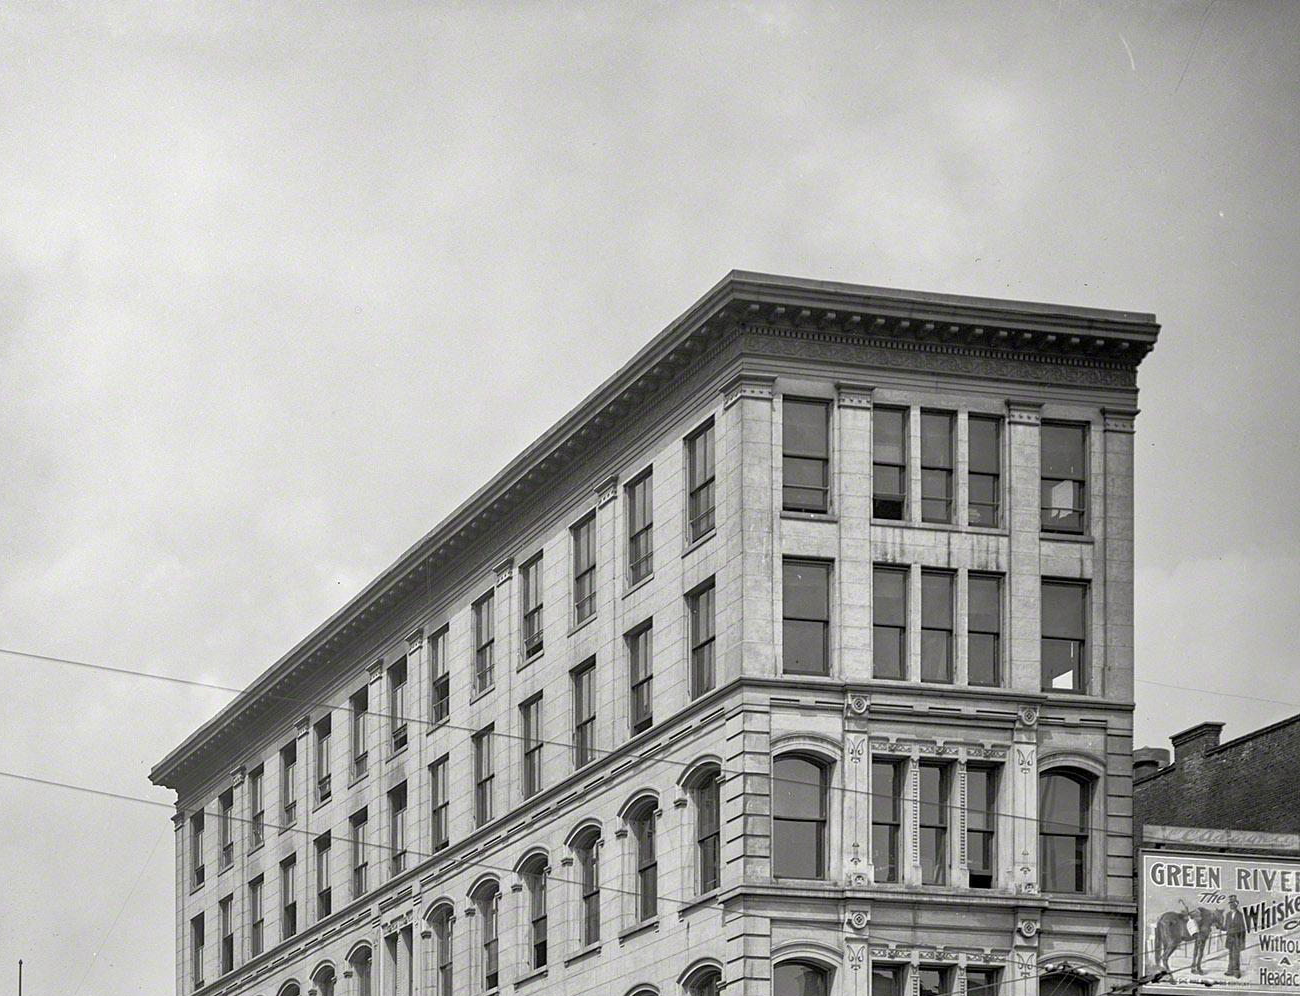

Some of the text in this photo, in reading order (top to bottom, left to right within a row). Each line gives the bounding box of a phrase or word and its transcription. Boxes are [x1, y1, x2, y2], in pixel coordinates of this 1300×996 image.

[1150, 862, 1221, 889] GREEN
[1200, 891, 1226, 904] The
[1279, 956, 1292, 966] A
